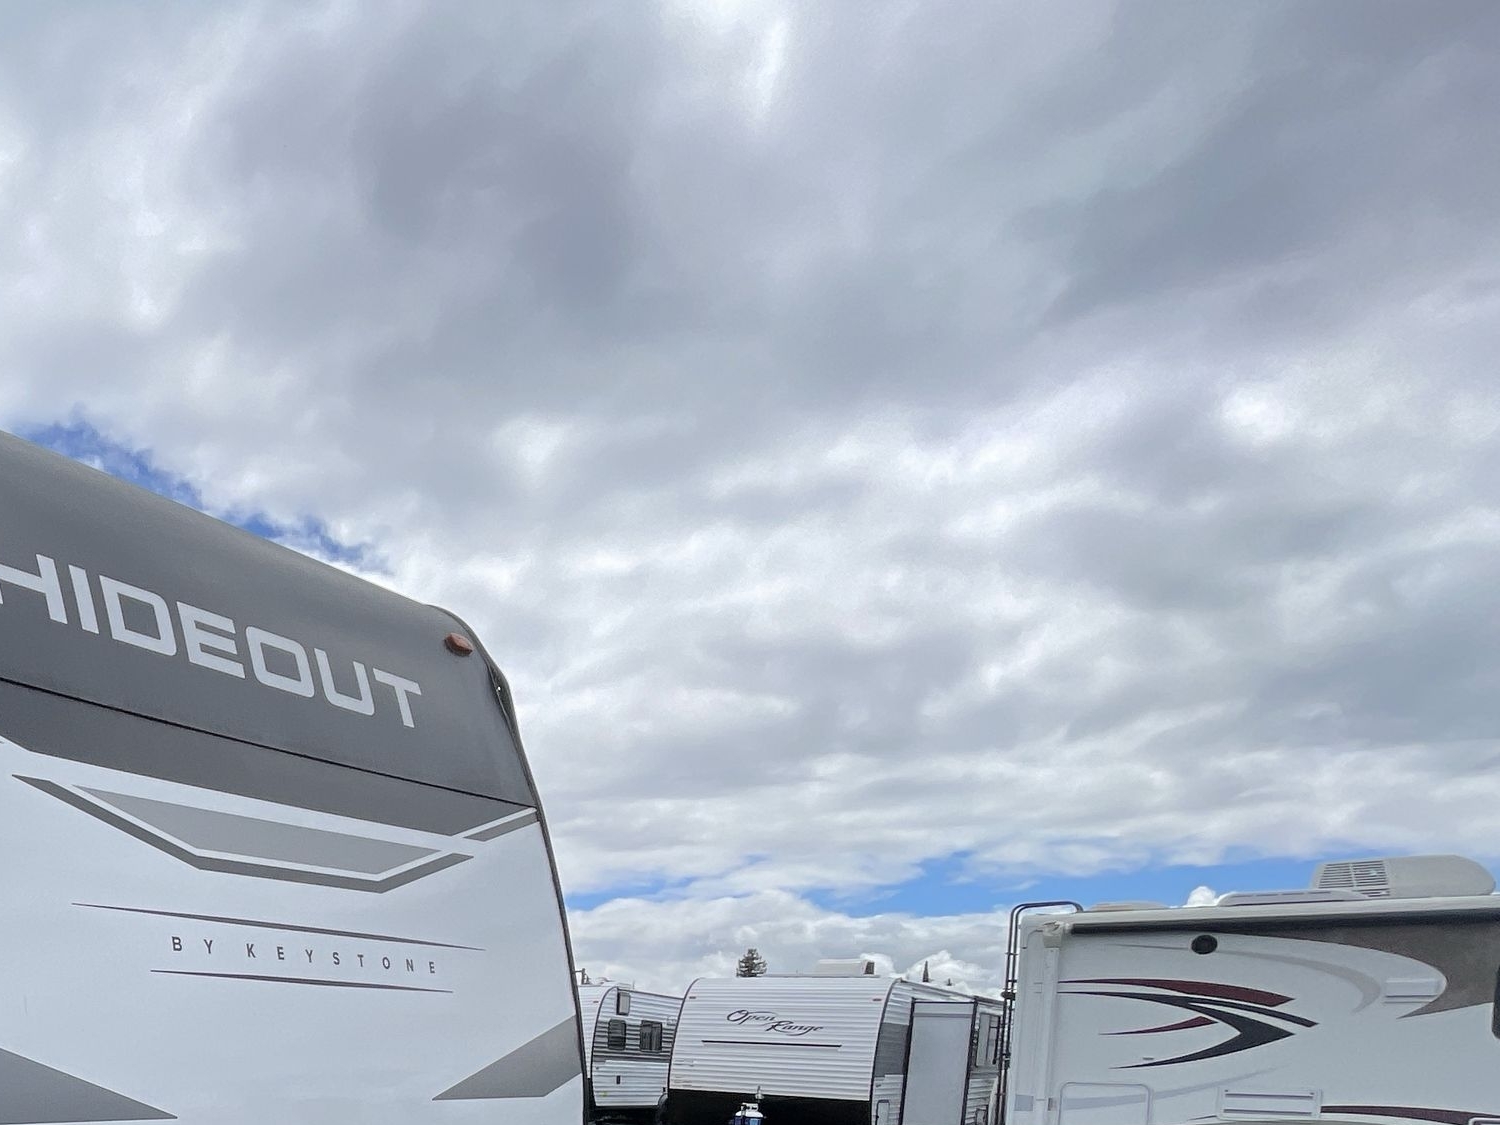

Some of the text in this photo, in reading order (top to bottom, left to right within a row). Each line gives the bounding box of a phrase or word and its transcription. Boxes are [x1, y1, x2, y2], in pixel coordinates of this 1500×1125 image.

[171, 936, 435, 974] BY KEYSTONE
[727, 1009, 778, 1025] Open
[763, 1020, 824, 1036] Range
